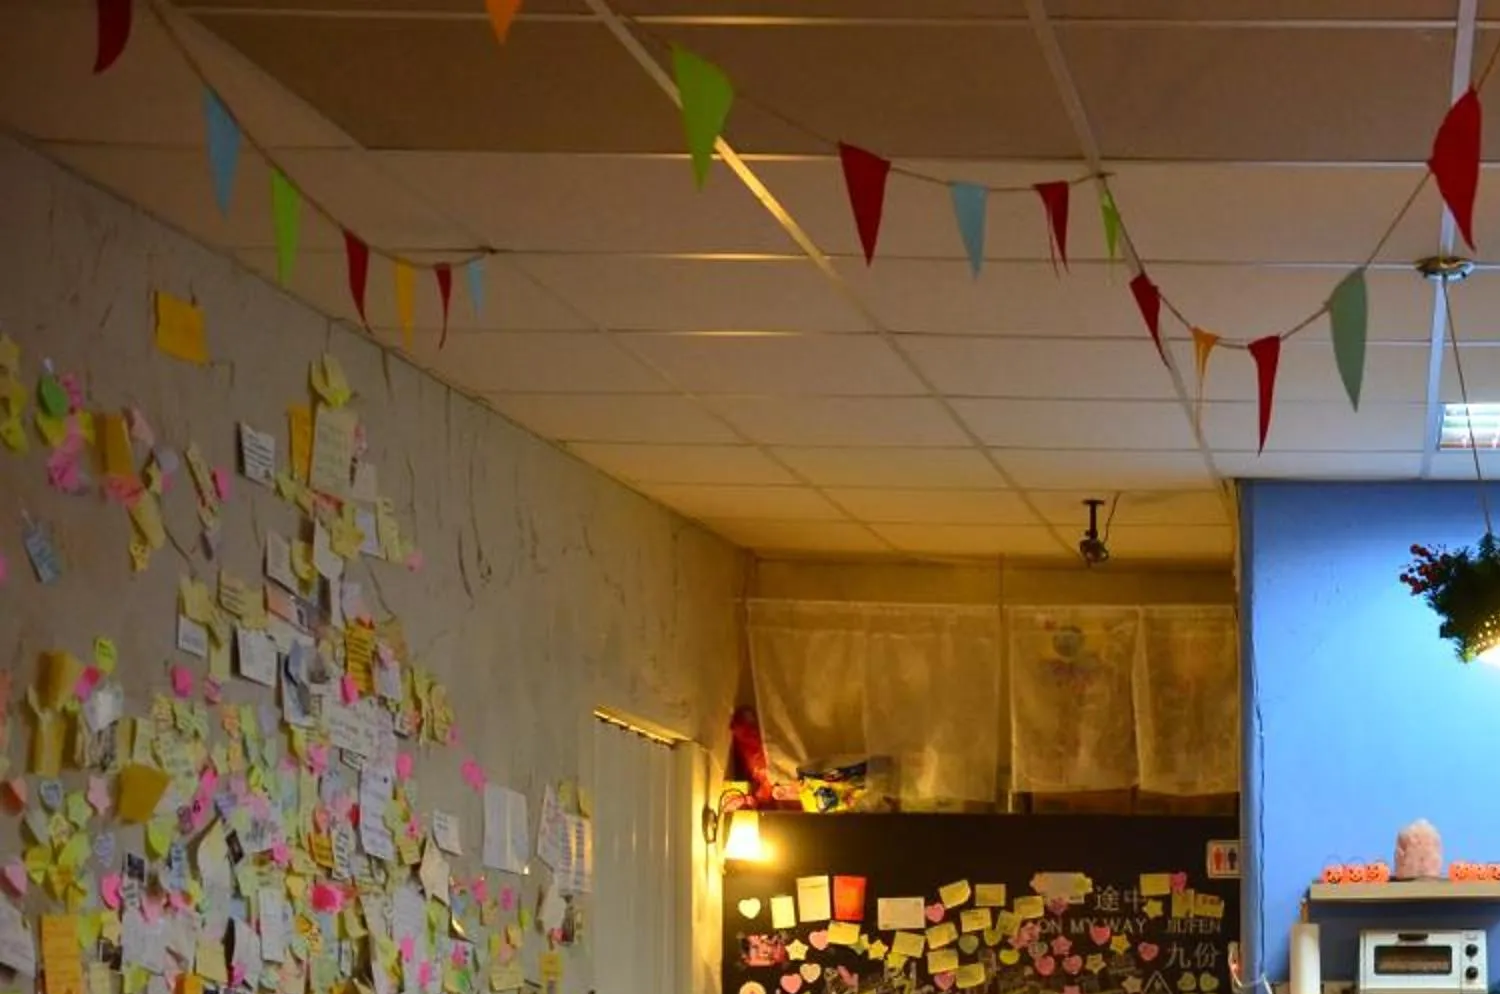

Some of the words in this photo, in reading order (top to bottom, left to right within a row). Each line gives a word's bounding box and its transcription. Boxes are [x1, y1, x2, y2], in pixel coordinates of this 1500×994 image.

[1093, 884, 1146, 914] 途中
[1039, 918, 1062, 934] ON
[1103, 917, 1147, 934] WAY
[1165, 941, 1221, 969] 九份
